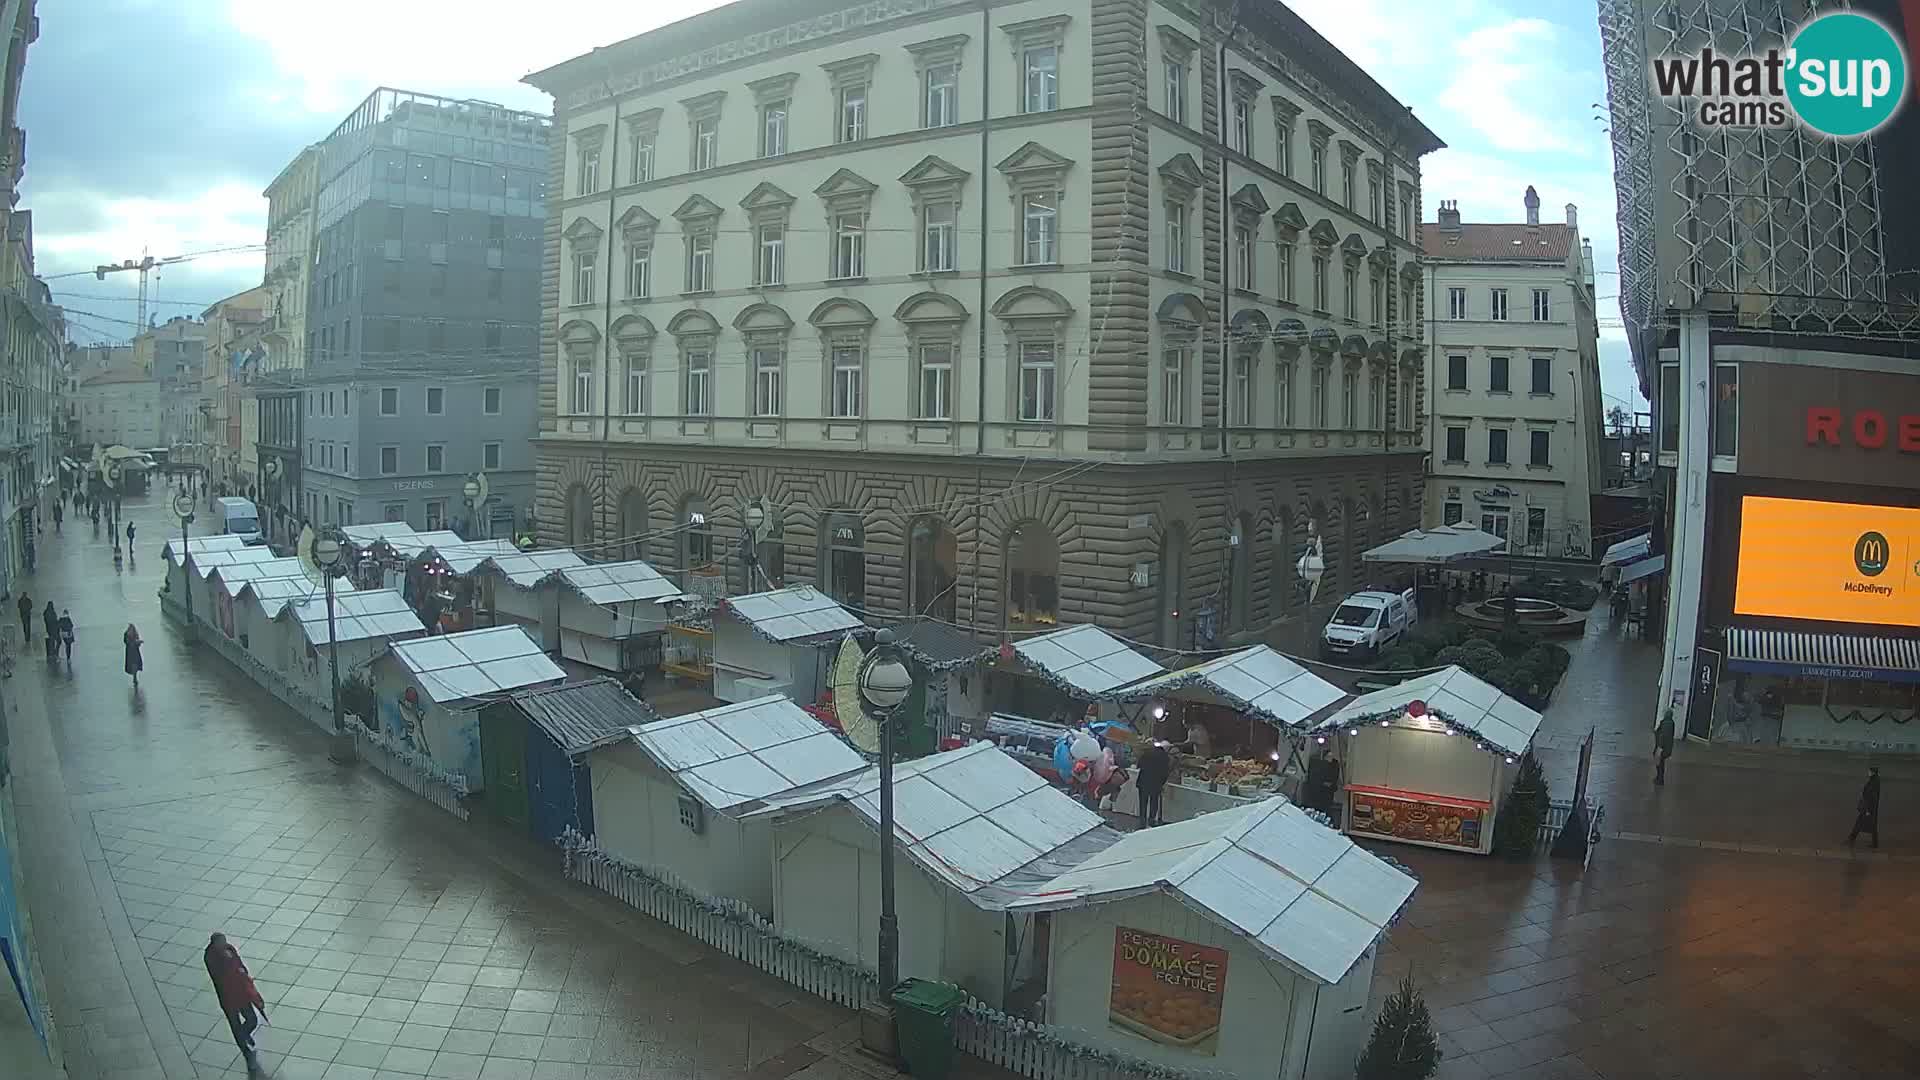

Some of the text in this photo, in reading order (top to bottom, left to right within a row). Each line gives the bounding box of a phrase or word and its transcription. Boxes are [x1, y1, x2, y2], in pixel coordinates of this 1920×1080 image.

[1844, 582, 1893, 597] McDelivery
[1121, 944, 1220, 981] DOMAĆE
[1155, 971, 1217, 993] FRITULE
